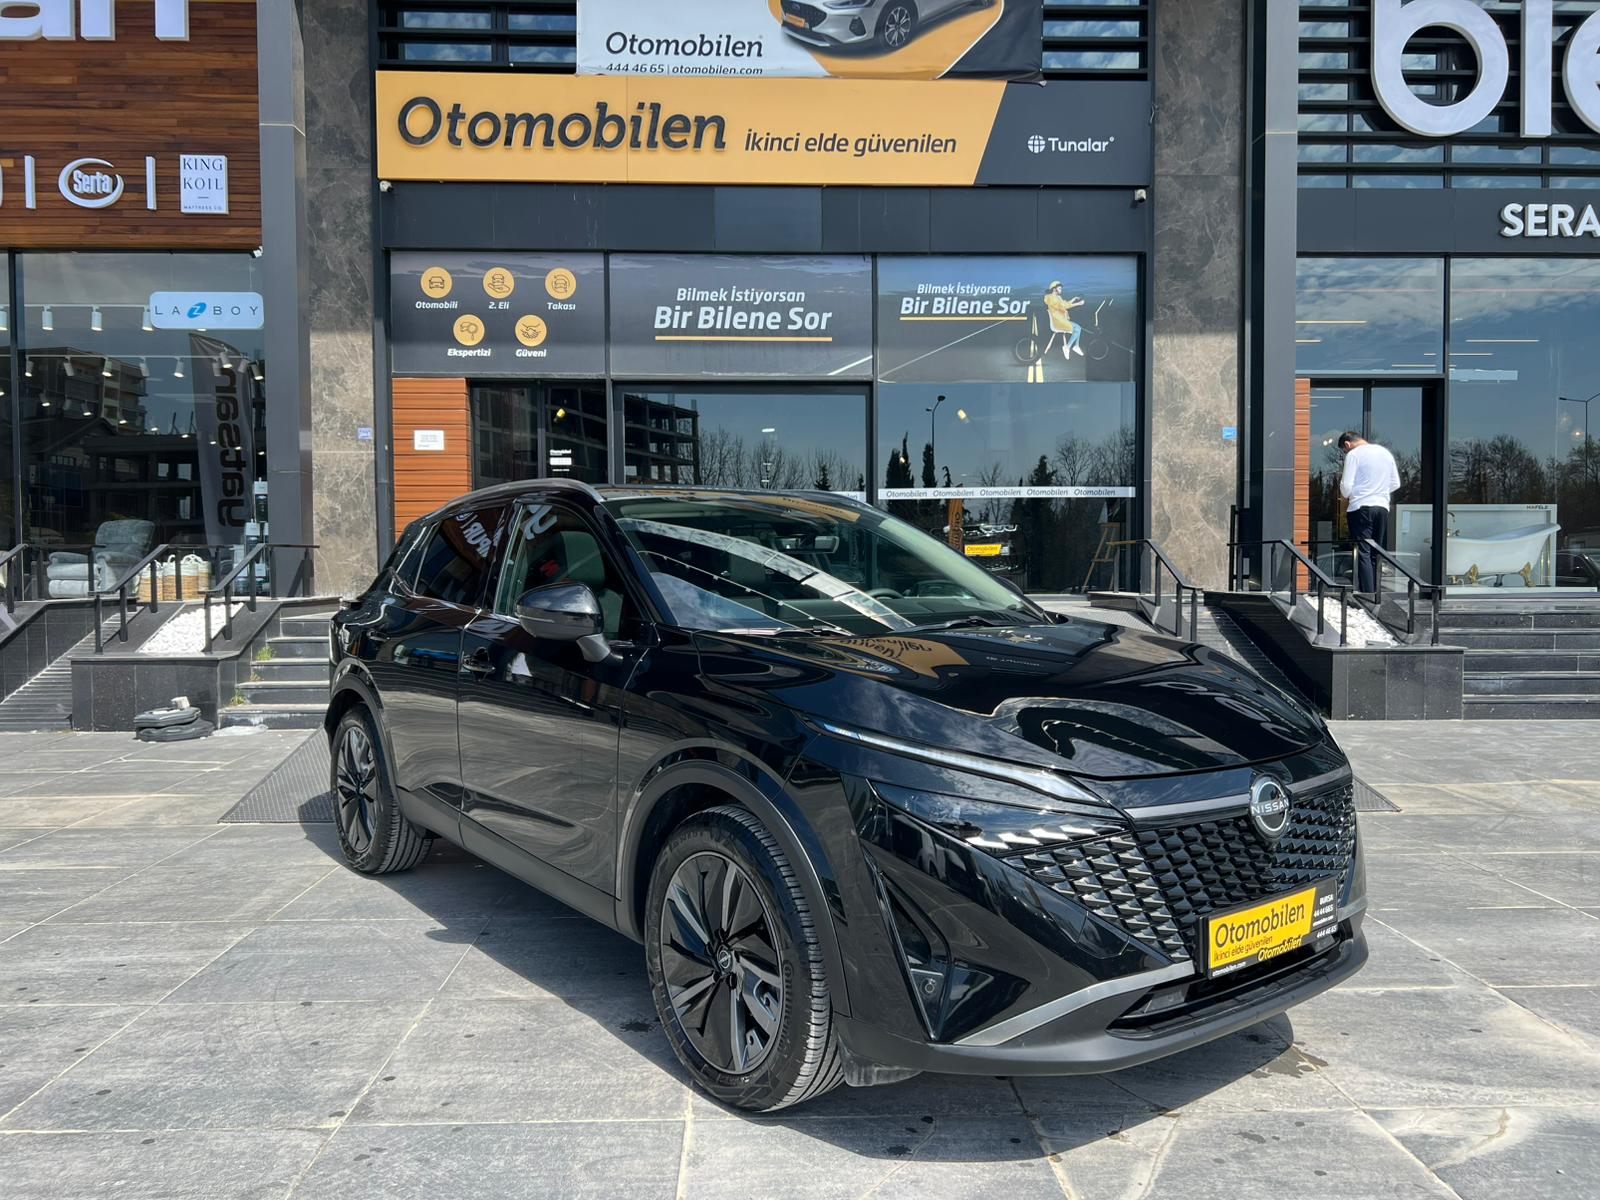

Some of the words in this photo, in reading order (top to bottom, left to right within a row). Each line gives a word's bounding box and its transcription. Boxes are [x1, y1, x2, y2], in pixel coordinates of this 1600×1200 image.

[606, 31, 763, 57] Otomobilen
[606, 63, 629, 72] 444
[632, 63, 647, 73] 46
[650, 64, 665, 74] 65
[672, 65, 763, 75] otomobilen.com
[398, 96, 727, 151] Otomobilen
[744, 128, 800, 151] İkinci
[804, 133, 849, 152] elde
[853, 133, 957, 157] güvenilen
[183, 158, 223, 170] KING
[73, 169, 113, 194] Serta
[183, 177, 223, 190] KOIL
[676, 287, 729, 302] Bilmek
[730, 286, 806, 305] İstiyorsan
[917, 283, 954, 294] Bilmek
[956, 282, 1011, 297] İstiyorsan
[415, 301, 458, 310] Otomobili
[488, 302, 497, 310] 2.
[498, 301, 510, 310] Eli
[546, 302, 576, 311] Takası
[900, 296, 929, 315] Bir
[932, 296, 993, 315] Bilene
[997, 297, 1031, 315] Sor
[654, 305, 693, 329] Bir
[697, 305, 782, 330] Bilene
[787, 306, 833, 330] Sor
[447, 348, 491, 358] Ekspertizi
[515, 348, 547, 358] Güveni
[886, 489, 928, 498] Otomobilen
[932, 489, 974, 498] Otomobilen
[979, 488, 1021, 497] Otomobilen
[1026, 488, 1068, 497] Otomobilen
[1073, 487, 1116, 497] Otomobilen
[1250, 798, 1289, 816] NISSAN
[1215, 903, 1305, 948] Otomobilen
